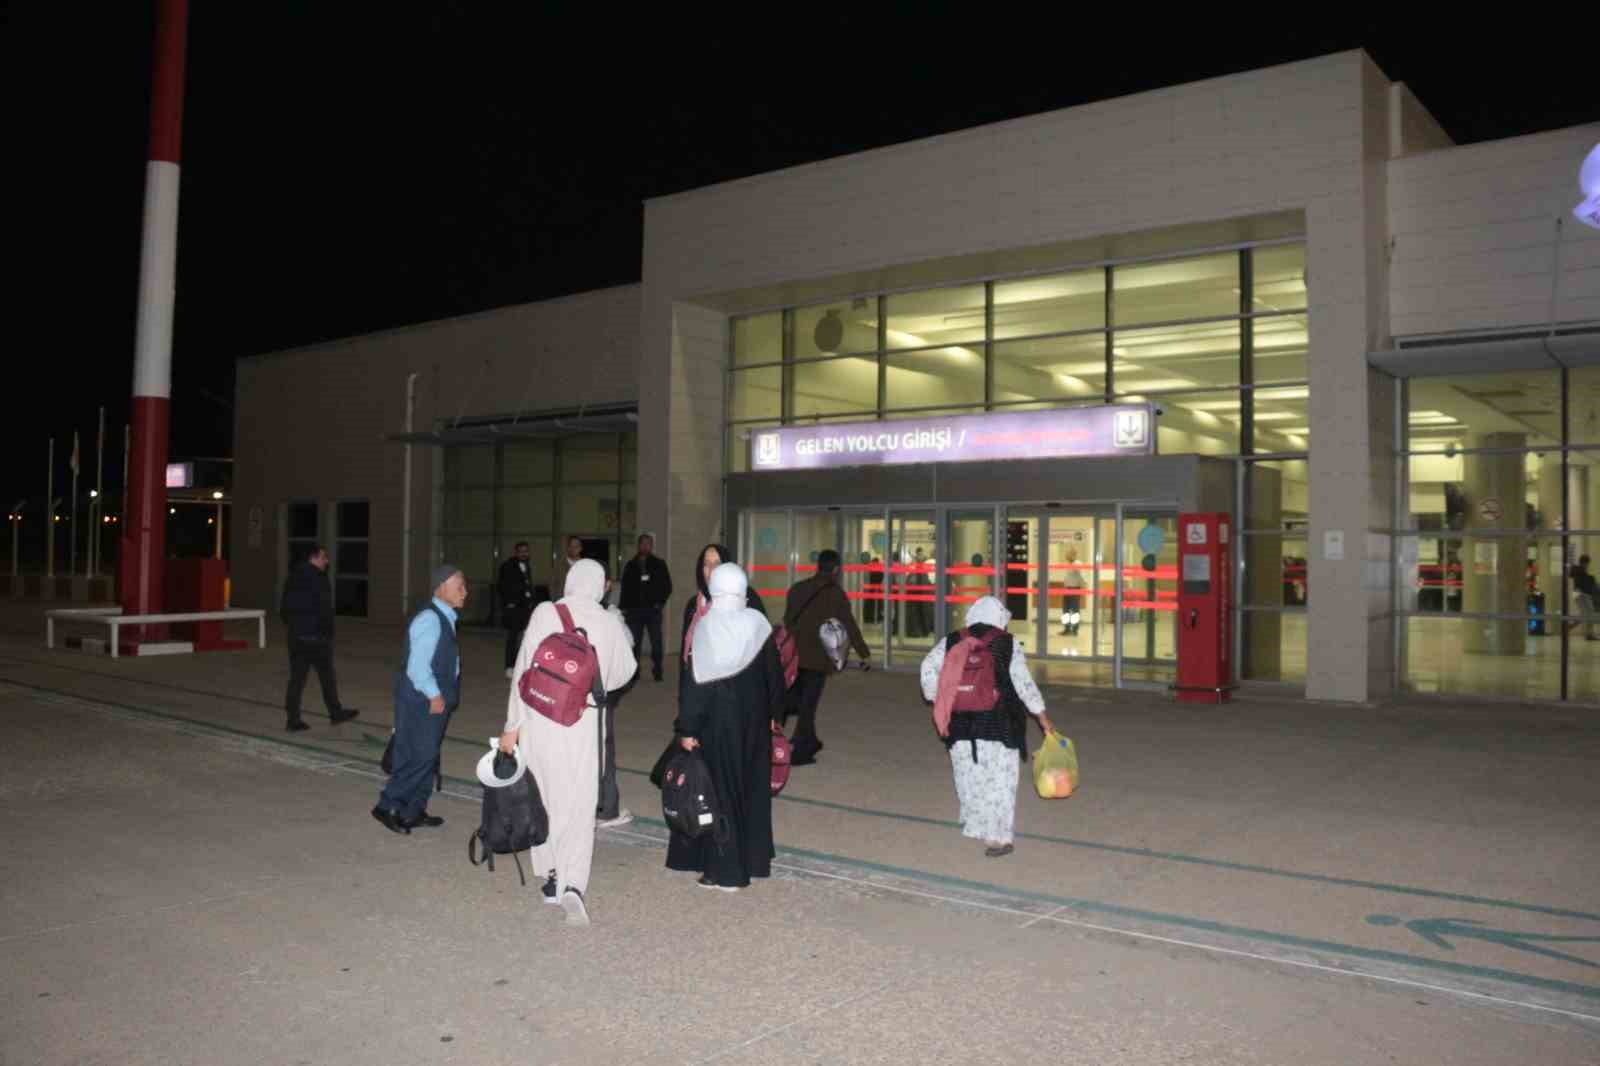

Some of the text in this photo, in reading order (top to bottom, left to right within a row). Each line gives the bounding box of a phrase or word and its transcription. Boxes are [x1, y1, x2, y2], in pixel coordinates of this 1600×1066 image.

[795, 437, 844, 455] GELEN
[847, 434, 898, 452] YOLCU
[902, 427, 951, 453] GİRİŞİ
[958, 429, 967, 448] /
